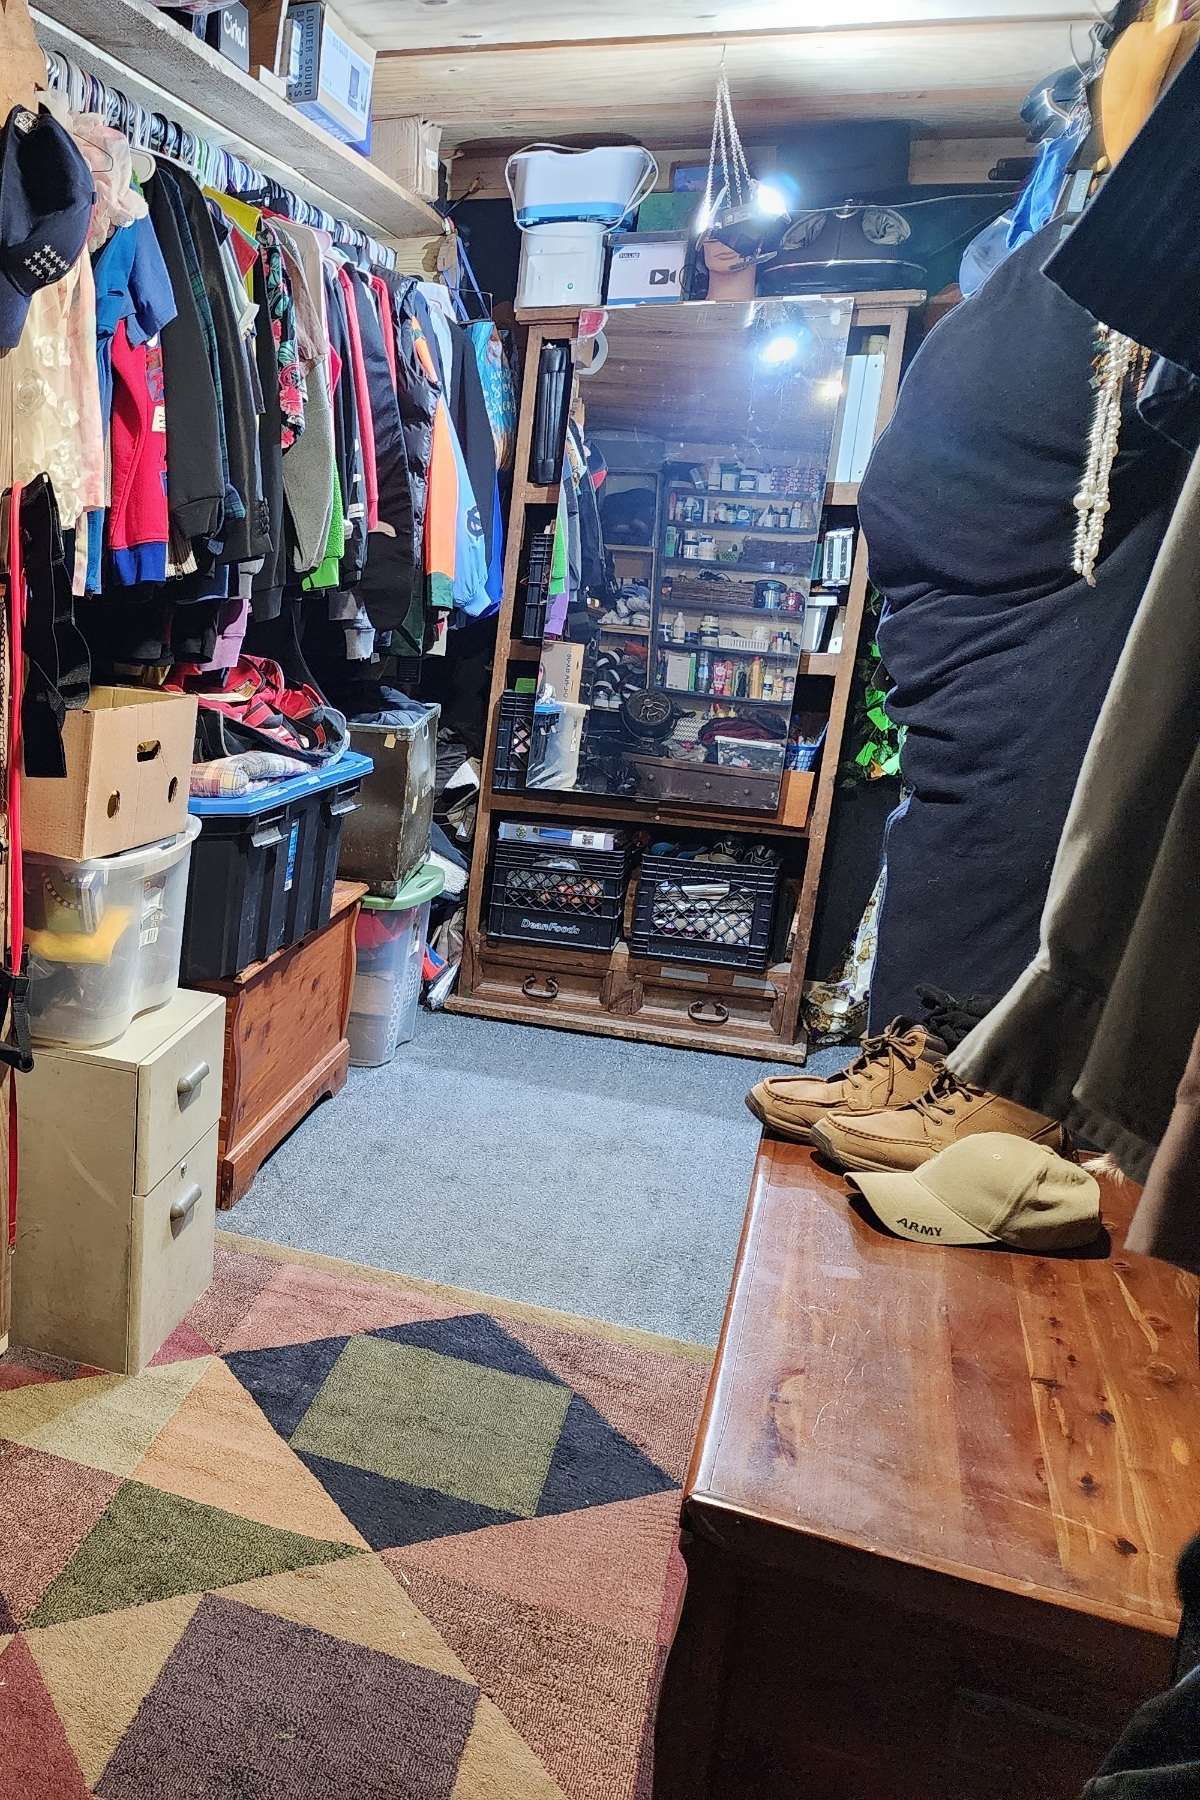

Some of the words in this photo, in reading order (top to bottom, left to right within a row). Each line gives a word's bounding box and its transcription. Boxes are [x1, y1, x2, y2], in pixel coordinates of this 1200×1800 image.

[223, 10, 247, 50] Cirkul
[305, 8, 315, 53] LOUDER
[304, 58, 314, 96] SOUND
[896, 1218, 942, 1237] ARMY
